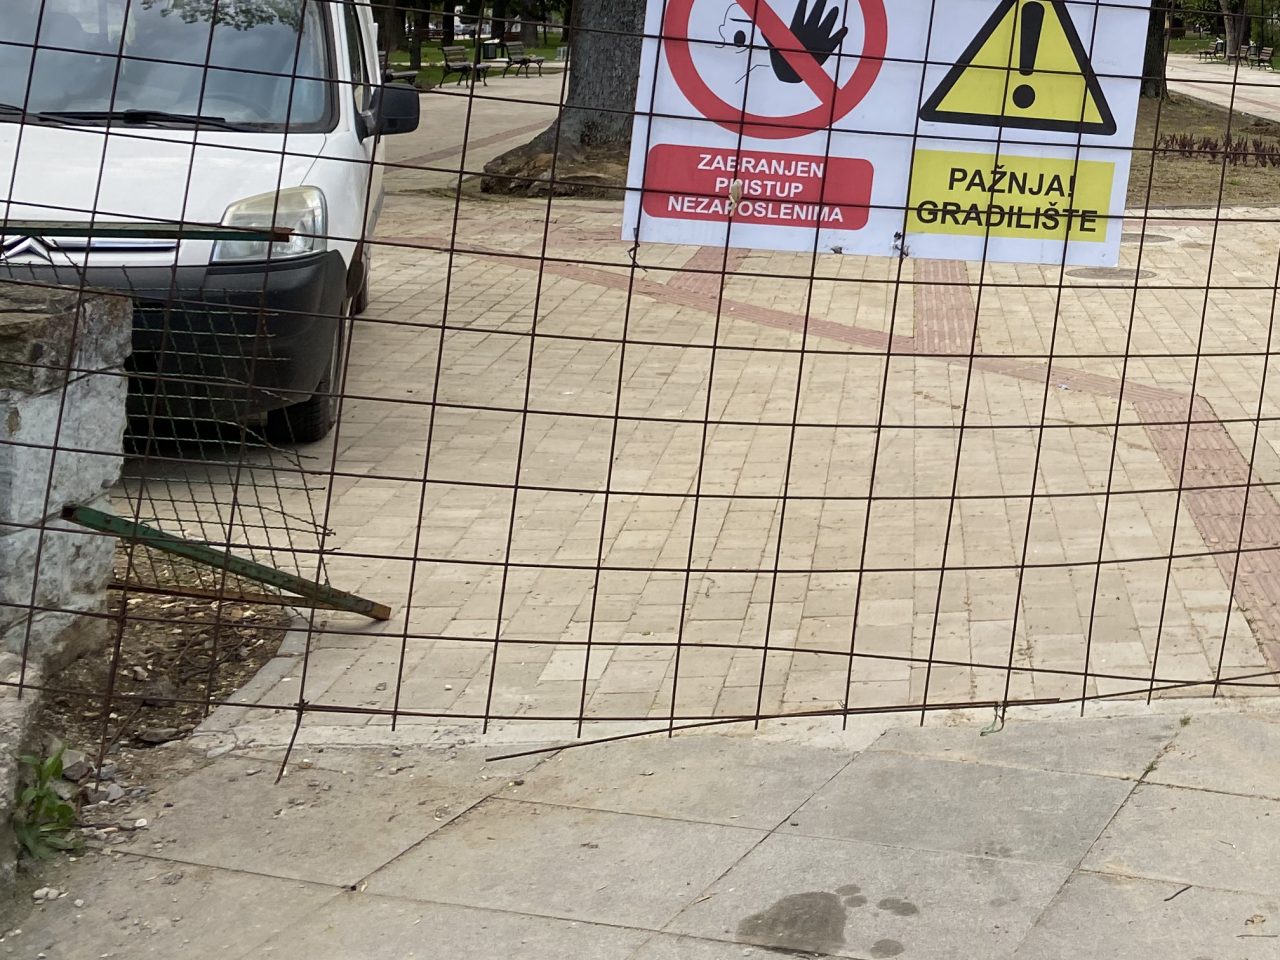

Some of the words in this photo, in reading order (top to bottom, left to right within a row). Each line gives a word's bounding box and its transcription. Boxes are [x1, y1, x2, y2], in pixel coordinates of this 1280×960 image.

[697, 154, 824, 178] ZABRANJEN
[948, 164, 1075, 198] PAŽNJA!
[916, 200, 1098, 232] GRADILIŠTE
